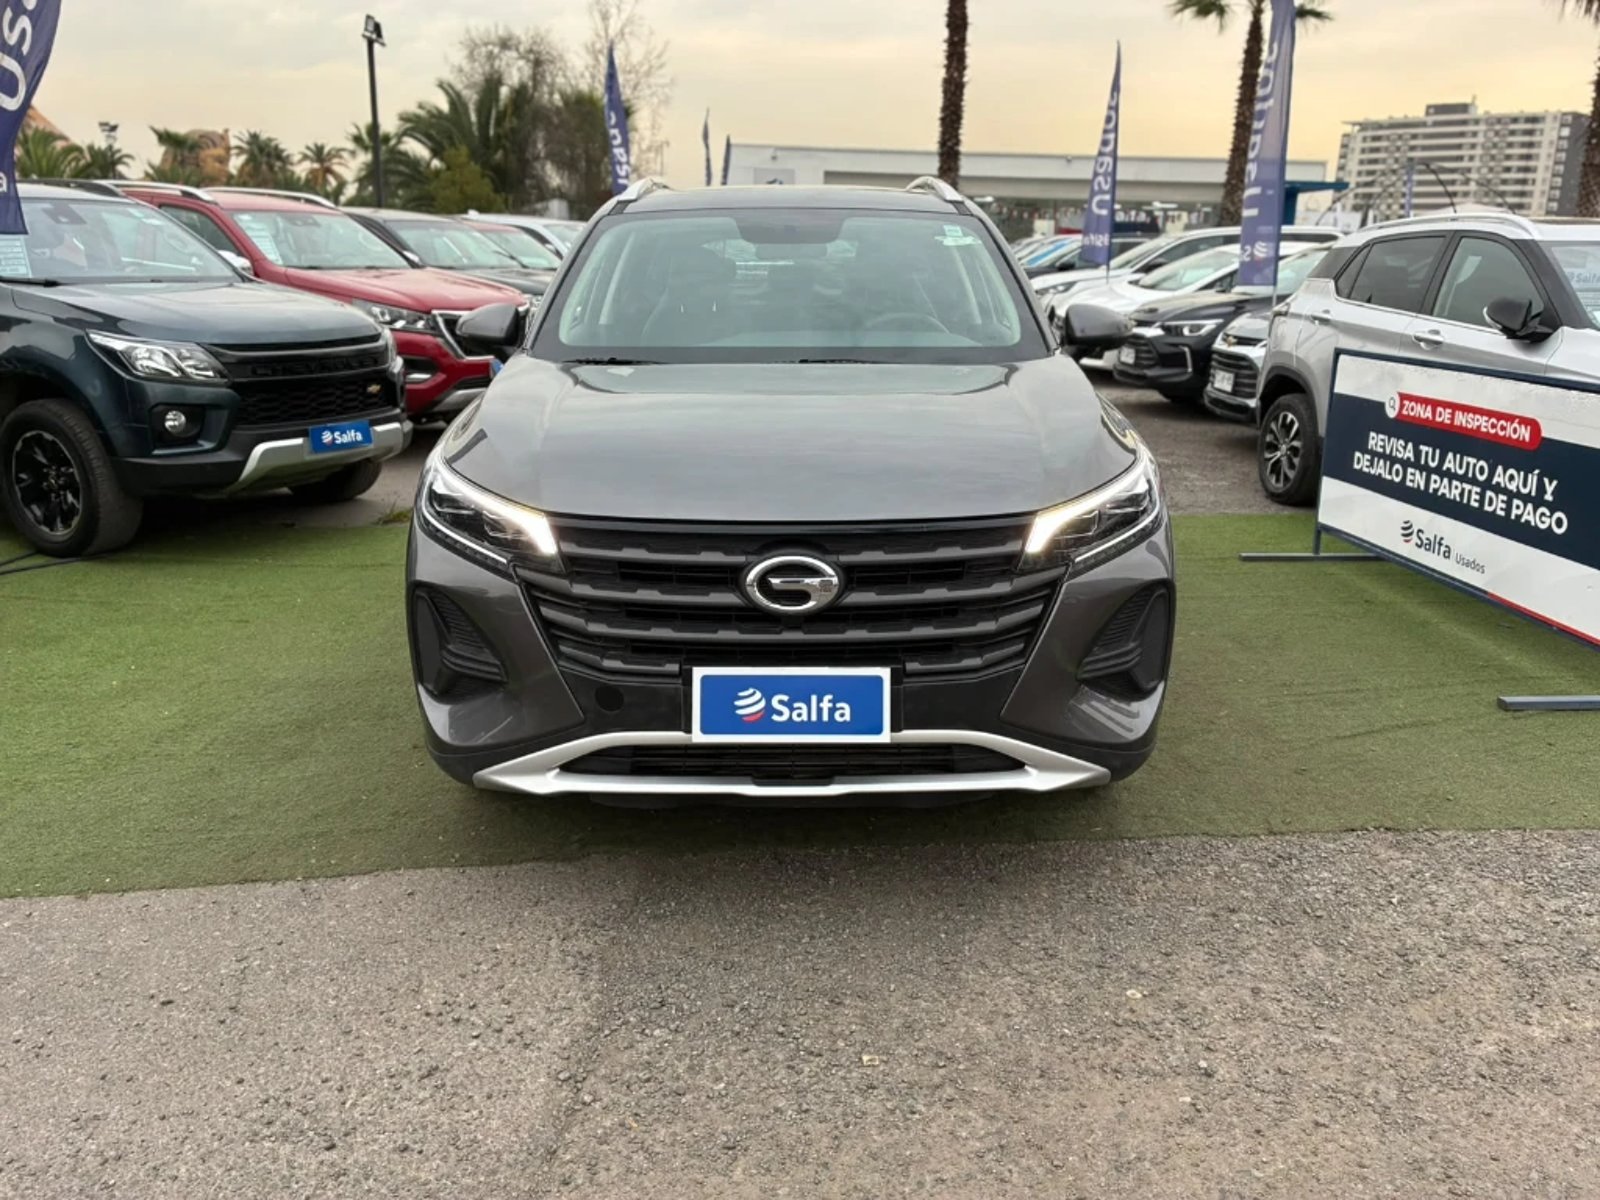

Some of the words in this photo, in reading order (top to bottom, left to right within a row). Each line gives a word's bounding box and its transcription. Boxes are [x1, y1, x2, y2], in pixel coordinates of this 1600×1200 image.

[334, 428, 364, 445] Salfa
[1402, 400, 1432, 421] ZONA
[1436, 407, 1453, 425] DE
[1454, 412, 1531, 442] INSPECCIÓN
[1368, 431, 1415, 461] REVISA
[1419, 445, 1440, 468] TU
[1443, 452, 1489, 480] AUTO
[1492, 465, 1540, 497] AQUÍ
[1543, 477, 1558, 501] Y
[1353, 451, 1403, 483] DEJALO
[1405, 470, 1426, 491] EN
[1429, 478, 1481, 508] PARTE
[1484, 491, 1508, 516] DE
[1511, 499, 1569, 535] PAGO
[1414, 527, 1452, 561] Salfa
[1454, 552, 1486, 575] Usados
[770, 693, 852, 723] Salfa
